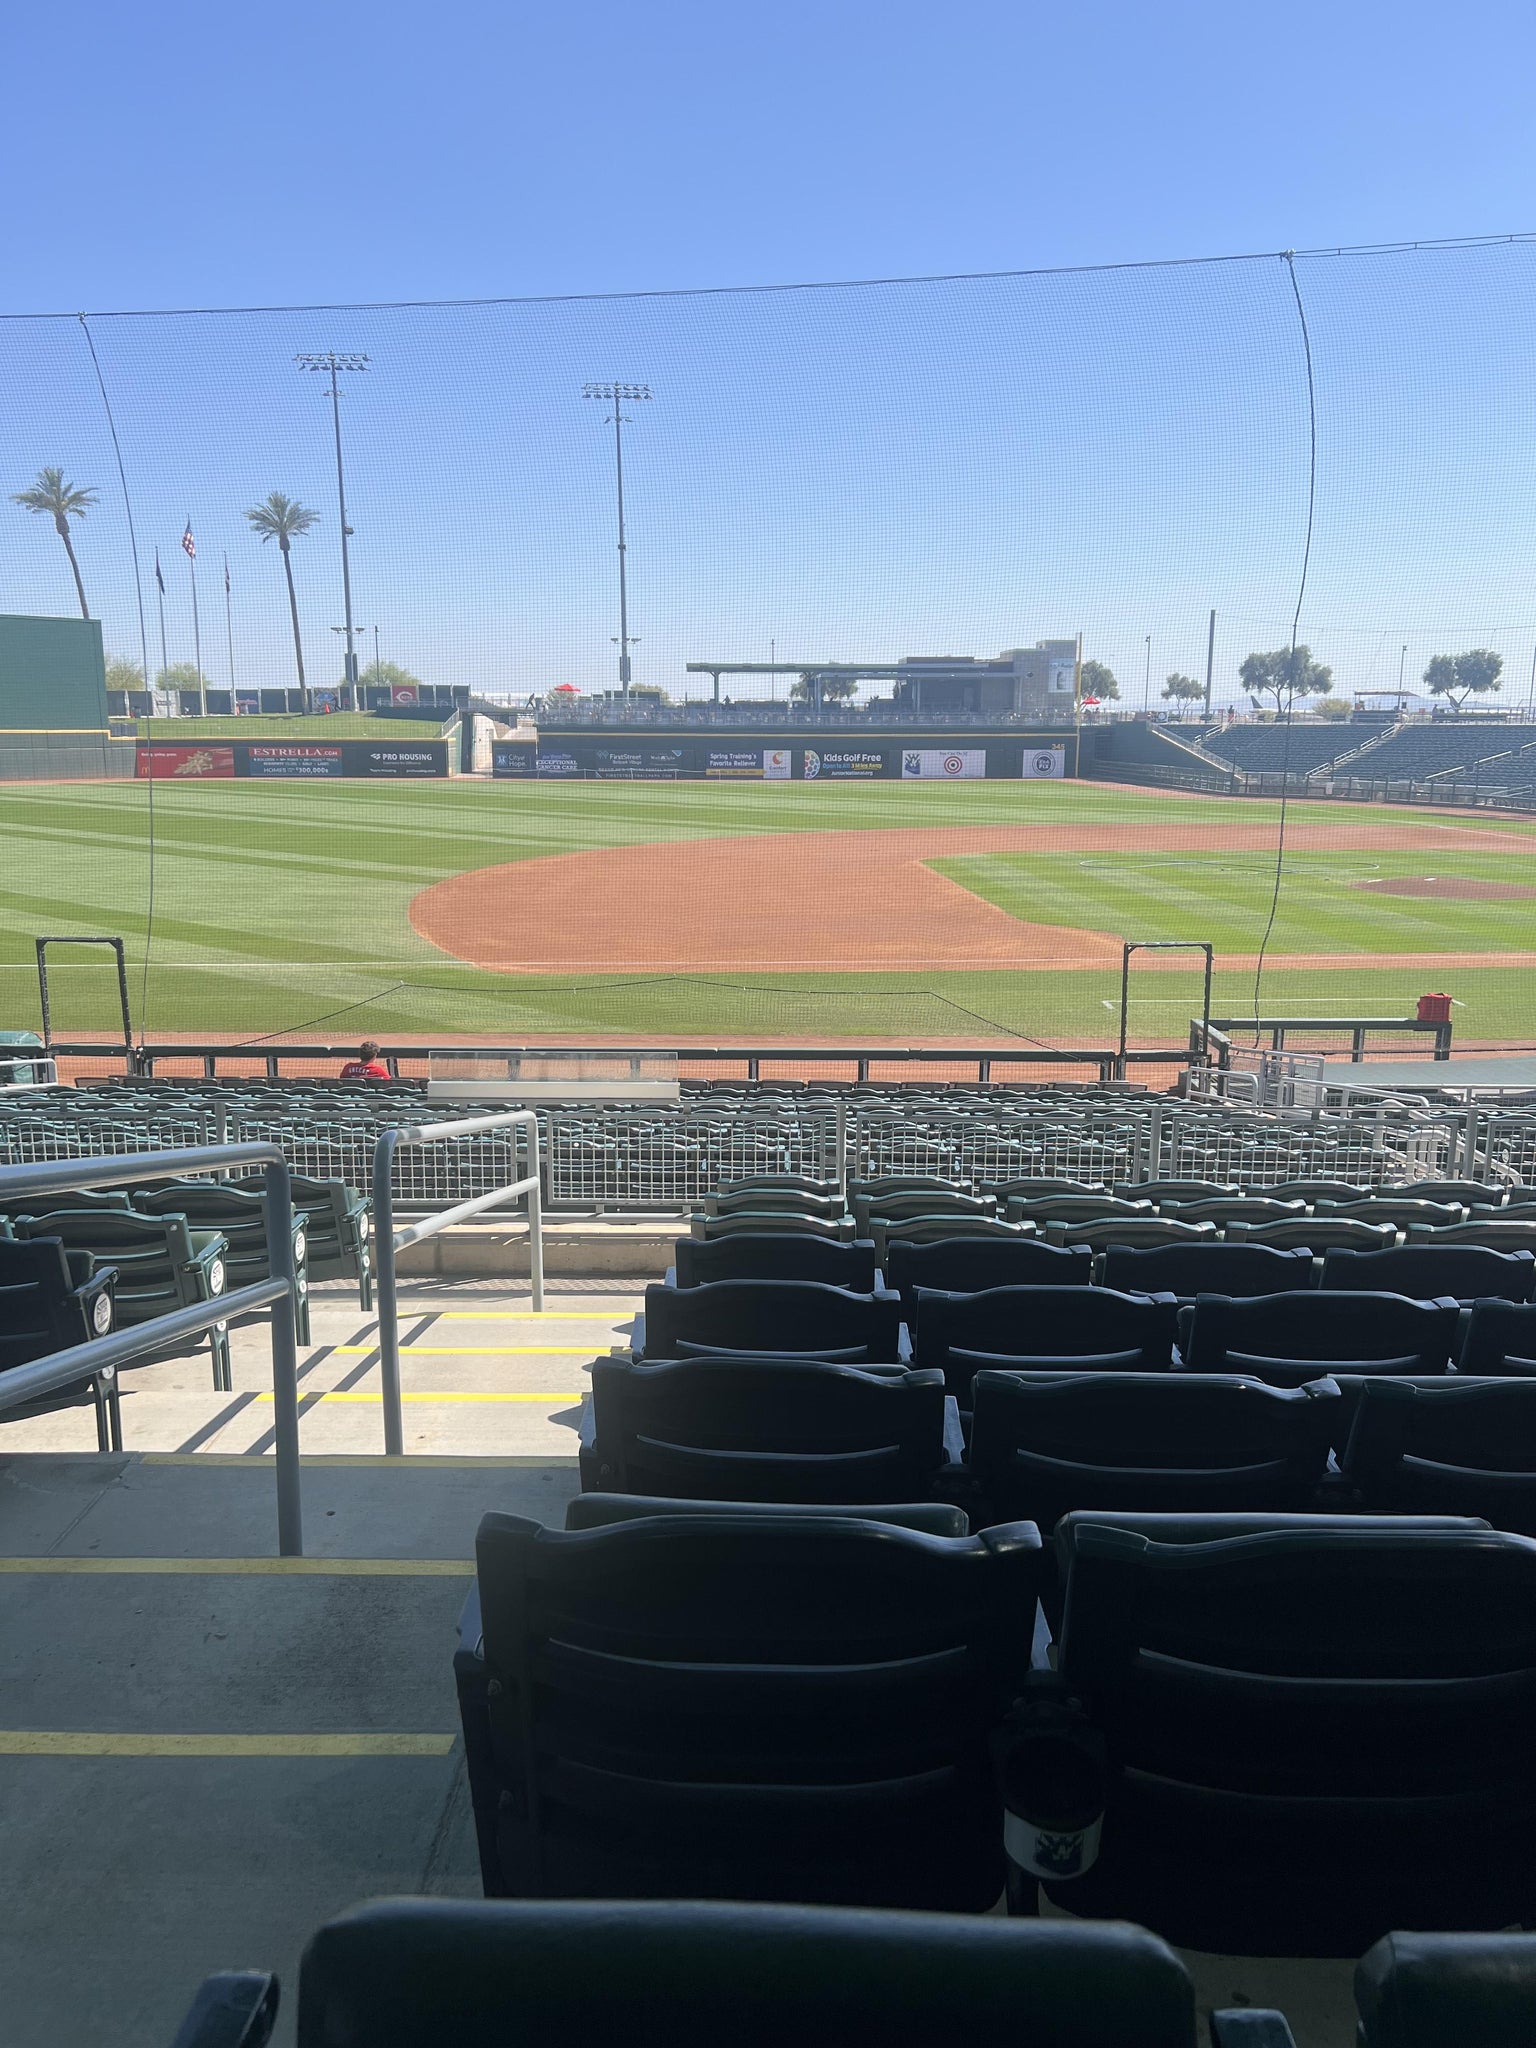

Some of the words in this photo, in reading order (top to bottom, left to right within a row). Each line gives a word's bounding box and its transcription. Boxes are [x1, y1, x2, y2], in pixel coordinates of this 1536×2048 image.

[710, 752, 728, 760] Spring
[823, 753, 842, 762] Kids
[842, 753, 861, 762] Golf
[862, 753, 882, 762] Free
